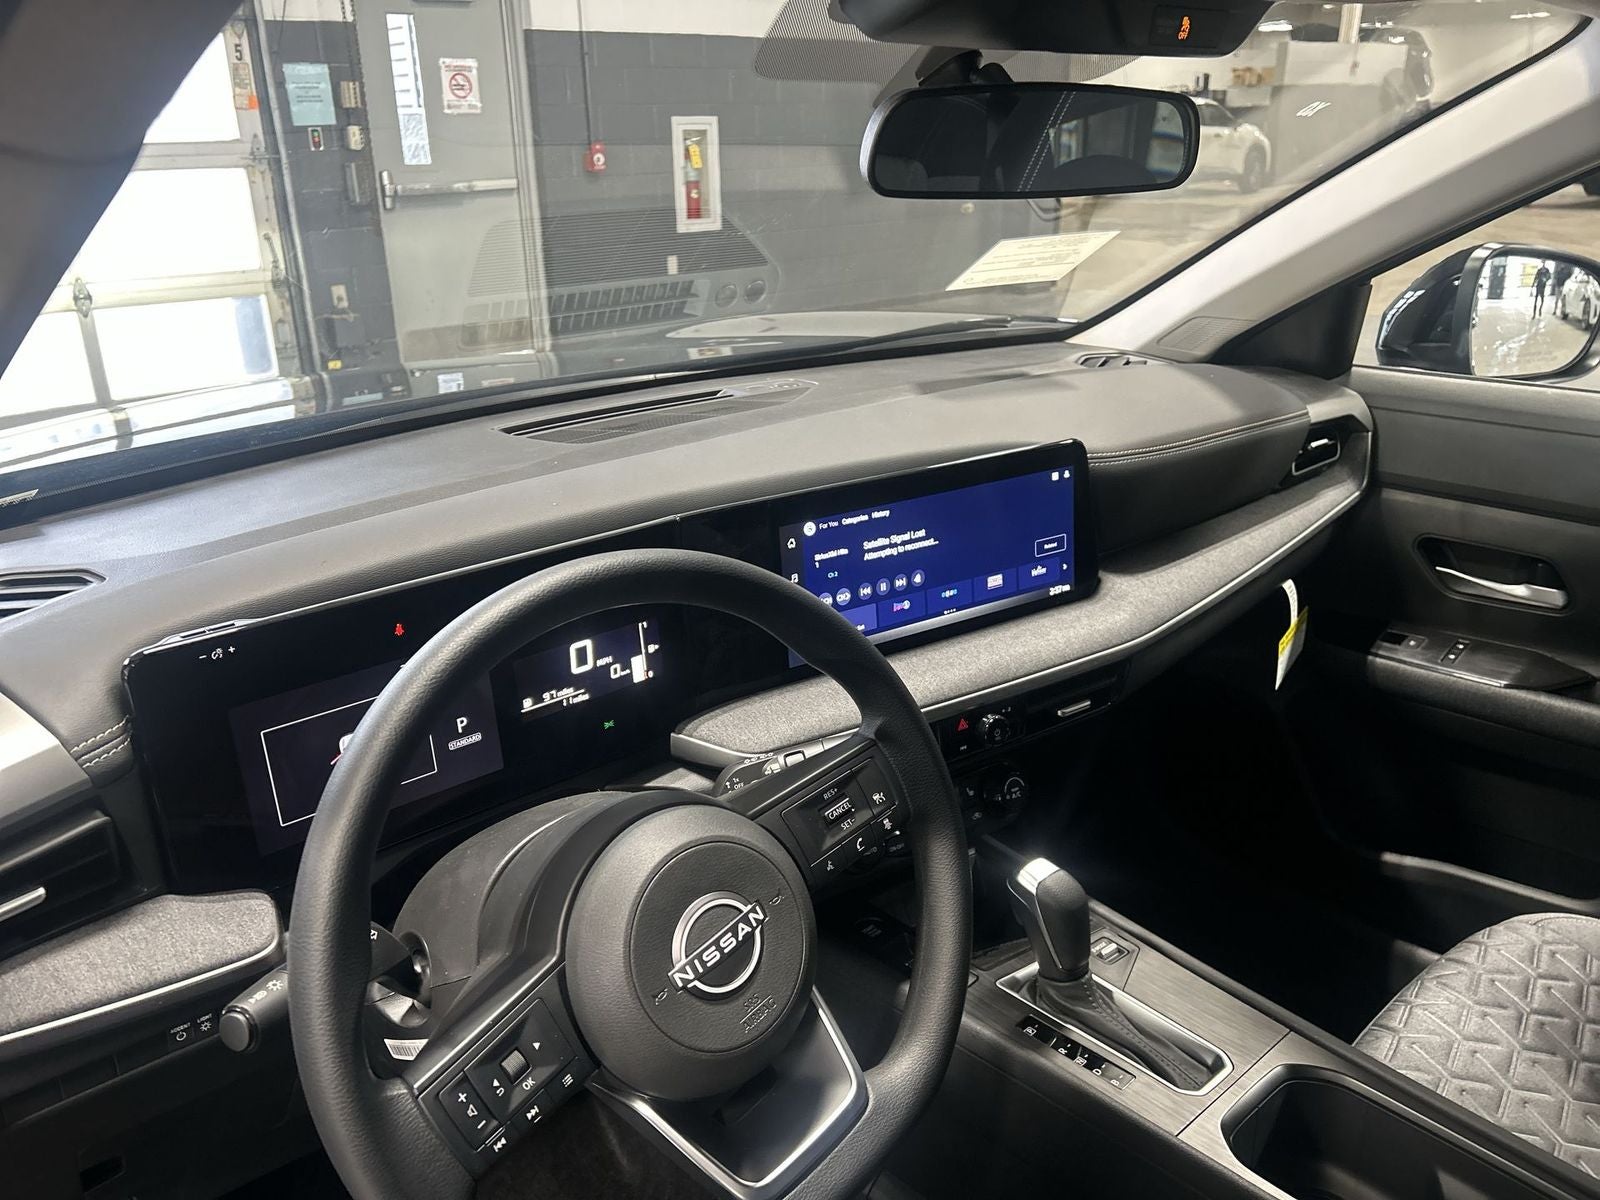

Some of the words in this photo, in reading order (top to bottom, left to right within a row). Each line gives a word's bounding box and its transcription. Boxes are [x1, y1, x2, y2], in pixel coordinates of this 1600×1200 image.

[234, 43, 243, 61] 5
[819, 522, 828, 530] For
[828, 520, 839, 528] You
[862, 536, 890, 550] Satellite
[890, 531, 911, 544] Signal
[910, 528, 926, 539] Lost
[863, 546, 898, 561] Attempting
[897, 544, 905, 553] to
[569, 638, 594, 675] 0
[610, 663, 620, 679] 0
[456, 716, 467, 733] P
[448, 732, 482, 750] STANDARD
[733, 782, 744, 790] OFF
[823, 788, 838, 800] RES+
[828, 801, 852, 820] CANCEL
[840, 818, 856, 830] SET-
[672, 905, 765, 988] NISSAN
[1092, 1068, 1102, 1076] D
[522, 1077, 536, 1090] OK
